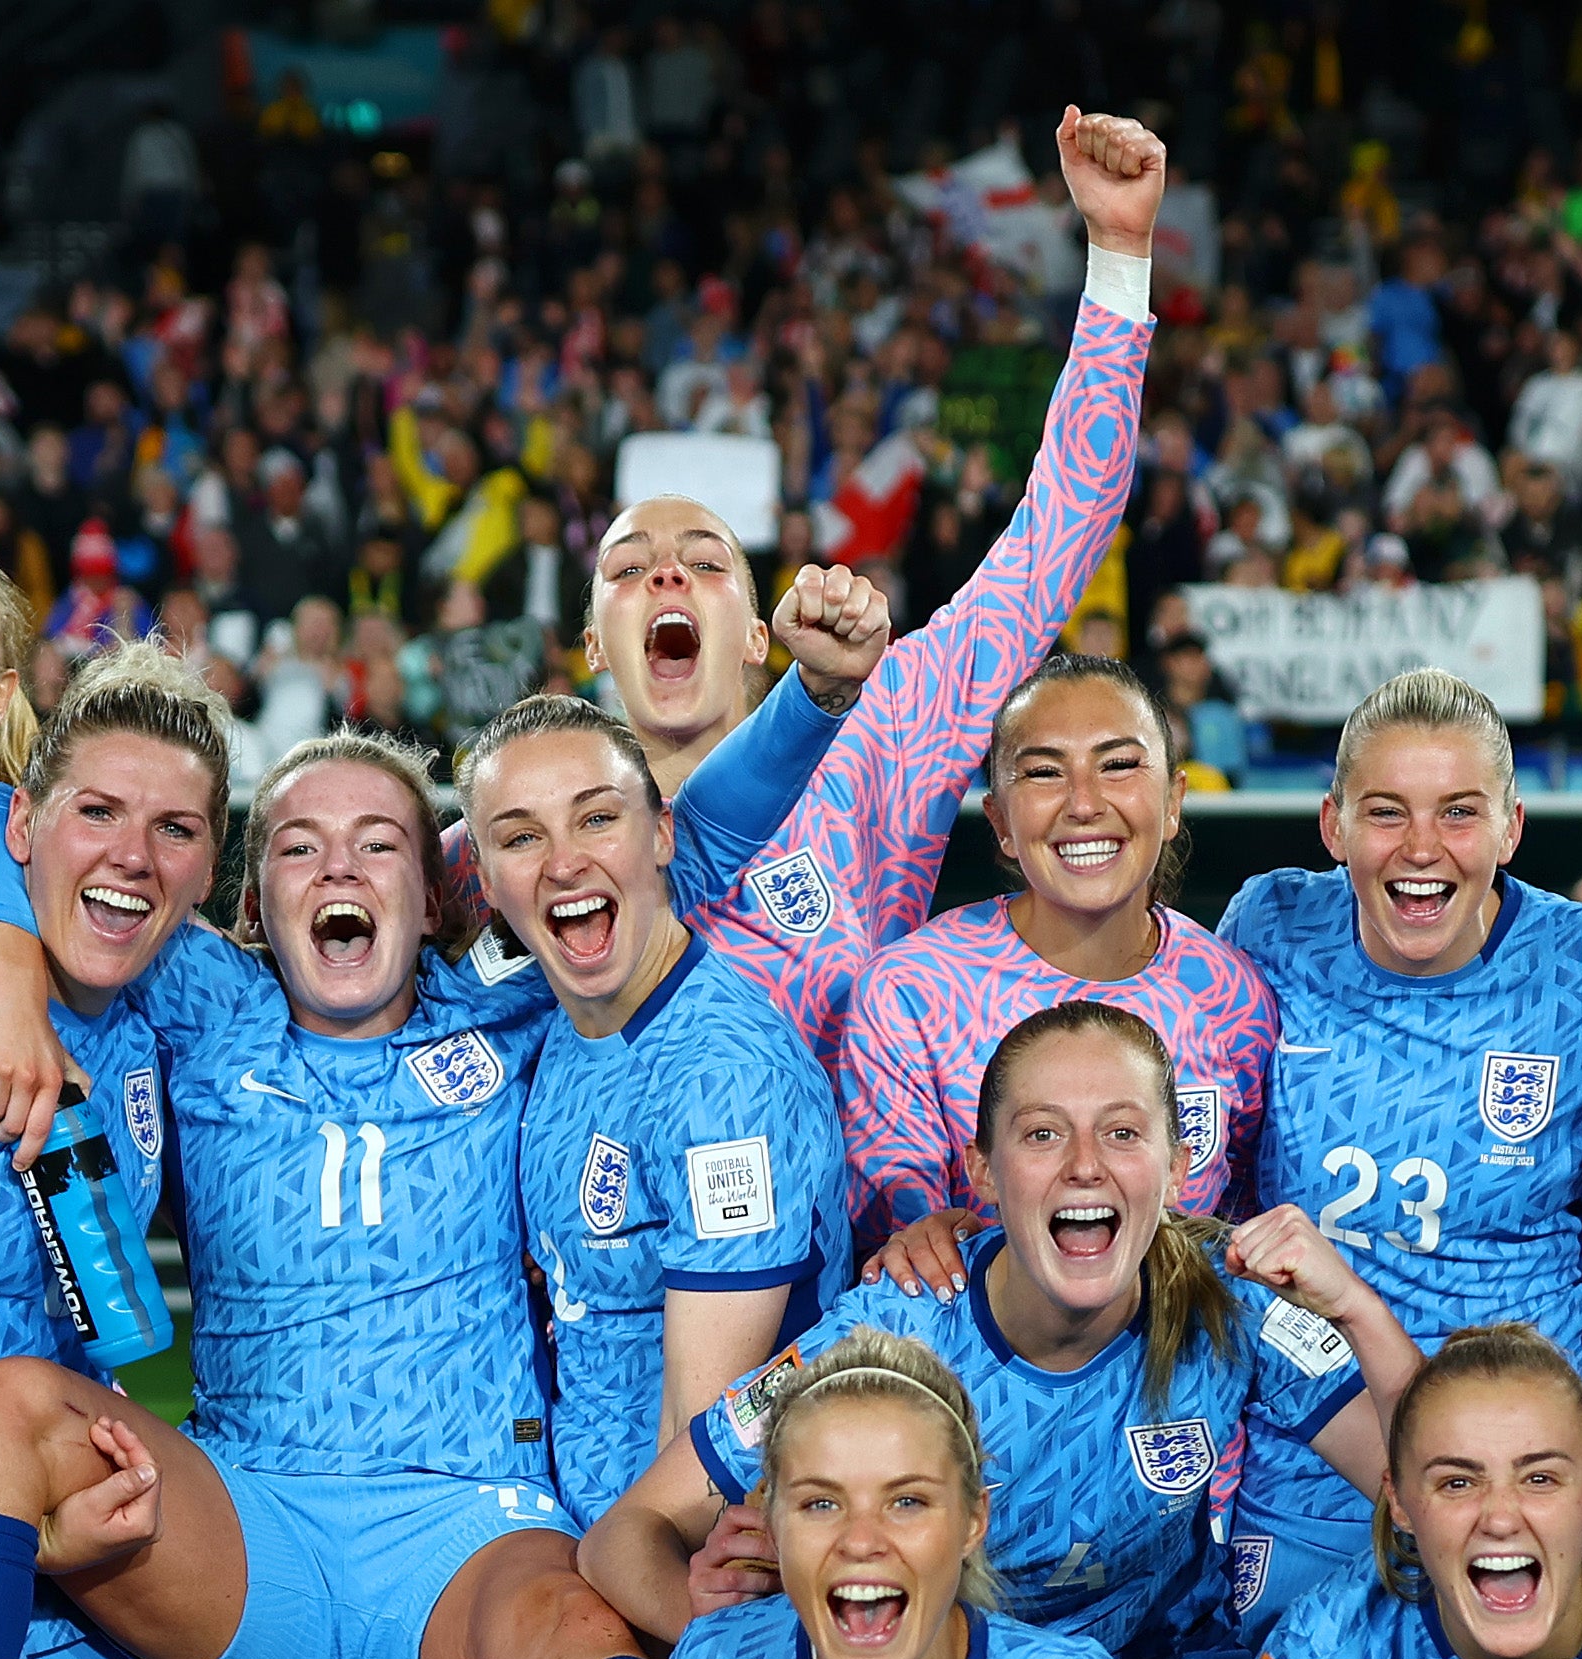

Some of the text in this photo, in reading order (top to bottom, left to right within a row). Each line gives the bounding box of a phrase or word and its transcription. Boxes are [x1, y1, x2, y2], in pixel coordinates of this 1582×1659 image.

[1490, 1144, 1527, 1155] AUSTRALIA
[705, 1155, 752, 1173] FOOTBALL
[1516, 1156, 1535, 1167] 2023
[317, 1121, 385, 1227] 11
[707, 1168, 754, 1190] UNITES
[708, 1184, 758, 1206] the World
[1319, 1146, 1448, 1254] 23
[724, 1206, 746, 1218] FIFA
[20, 1169, 89, 1332] POWERADE
[1288, 1311, 1320, 1340] UNITE
[1043, 1542, 1106, 1591] 4
